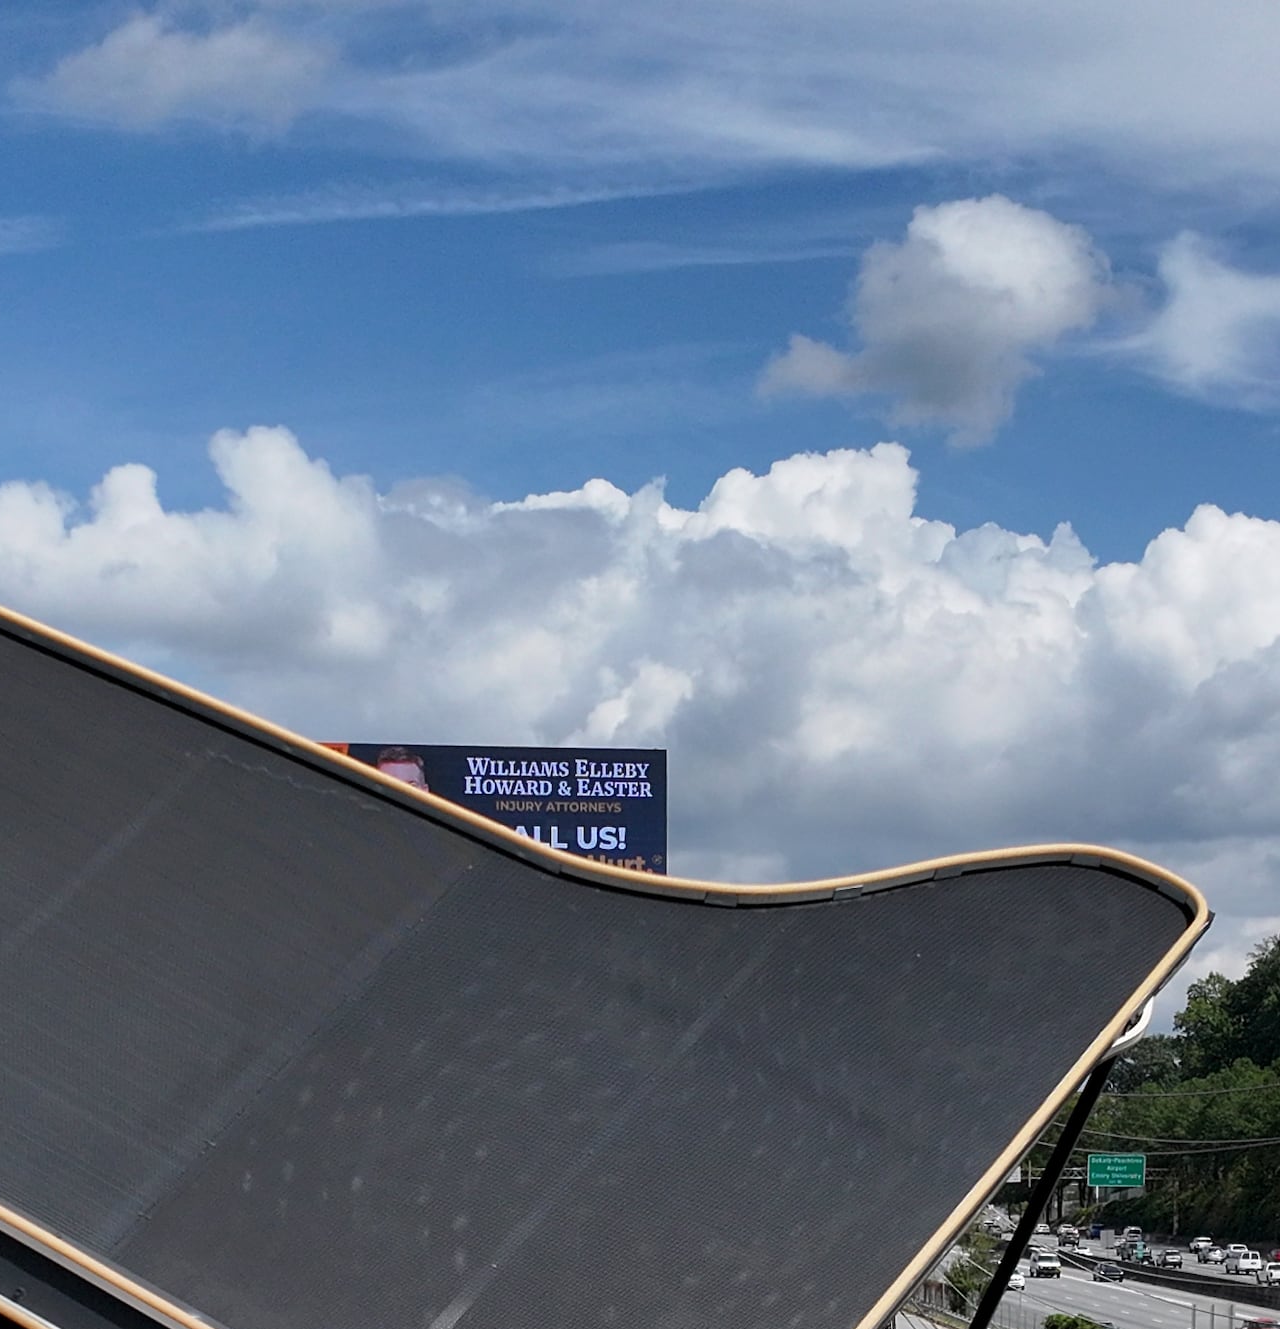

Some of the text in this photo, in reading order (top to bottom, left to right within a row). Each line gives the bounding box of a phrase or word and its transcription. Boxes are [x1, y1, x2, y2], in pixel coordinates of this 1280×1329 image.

[467, 757, 649, 778] WILLIAMS ELLEBY
[465, 777, 652, 797] HOWARD & EASTER
[496, 801, 622, 813] INJURY ATTORNEYS
[515, 825, 626, 850] ALL US!
